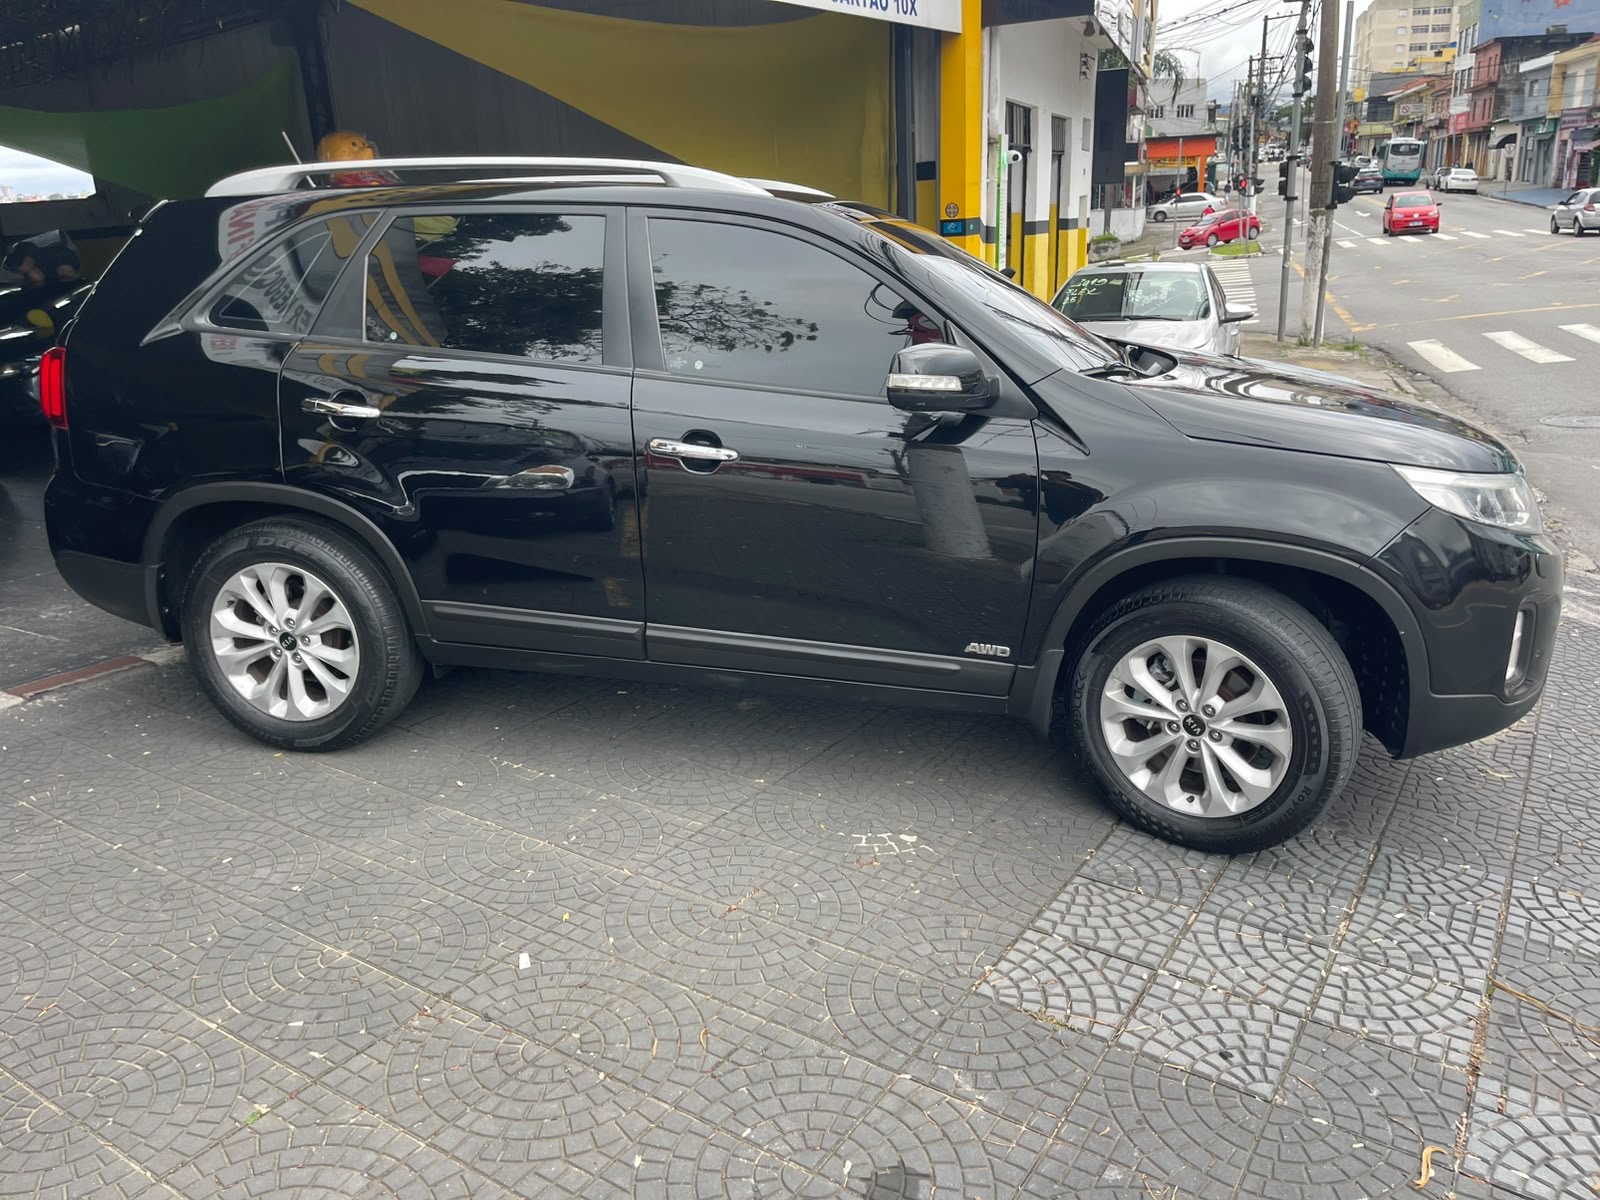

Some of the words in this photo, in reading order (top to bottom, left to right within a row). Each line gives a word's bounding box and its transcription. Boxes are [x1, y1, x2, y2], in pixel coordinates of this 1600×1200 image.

[281, 635, 295, 649] KIA
[963, 642, 1010, 657] AWD
[1185, 717, 1201, 735] KIA
